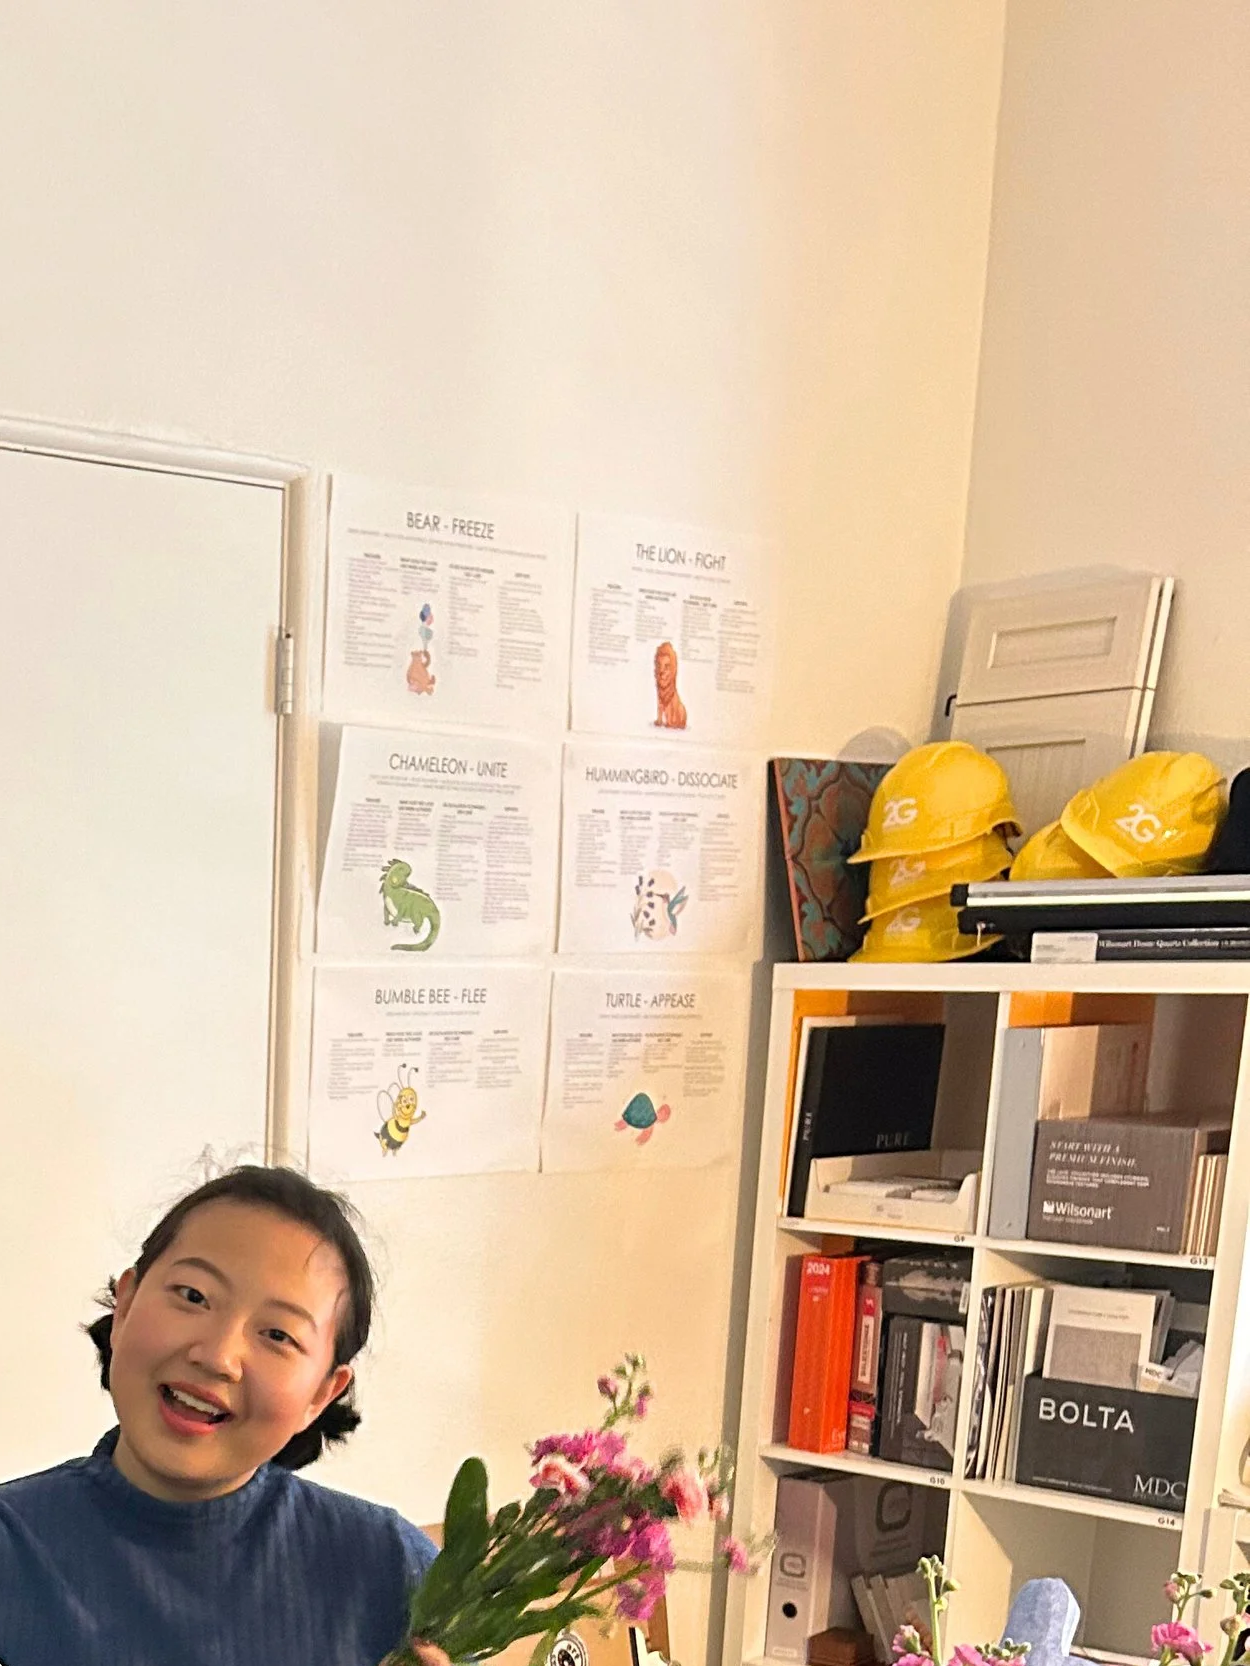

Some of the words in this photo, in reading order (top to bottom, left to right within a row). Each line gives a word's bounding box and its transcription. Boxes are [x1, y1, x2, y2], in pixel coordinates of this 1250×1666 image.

[407, 511, 440, 531] BEAR
[452, 518, 495, 540] FREEZE
[636, 543, 656, 561] THE
[658, 548, 686, 565] LION
[695, 552, 727, 570] FIGHT
[389, 753, 467, 775] CHAMELEON
[477, 762, 507, 778] UNITE
[585, 767, 669, 785] HUMMINGBIRD
[678, 771, 738, 789] DISSOCIATE
[882, 798, 918, 827] 2G
[1115, 804, 1160, 843] 2G
[375, 988, 425, 1005] BUMBLE
[428, 988, 450, 1004] BEE
[461, 988, 487, 1004] FLEE
[606, 993, 642, 1008] TURTLE
[650, 993, 696, 1008] APPEASE
[876, 1132, 910, 1148] PURE
[1050, 1141, 1080, 1151] START
[1084, 1143, 1111, 1153] WITH
[1049, 1152, 1097, 1164] PREMIUM
[1056, 1202, 1112, 1220] Wilsonart
[806, 1262, 830, 1276] 2024
[1190, 1257, 1208, 1266] G13
[1039, 1397, 1134, 1433] BOLTA
[1133, 1473, 1186, 1498] MDC
[1158, 1516, 1175, 1526] G14
